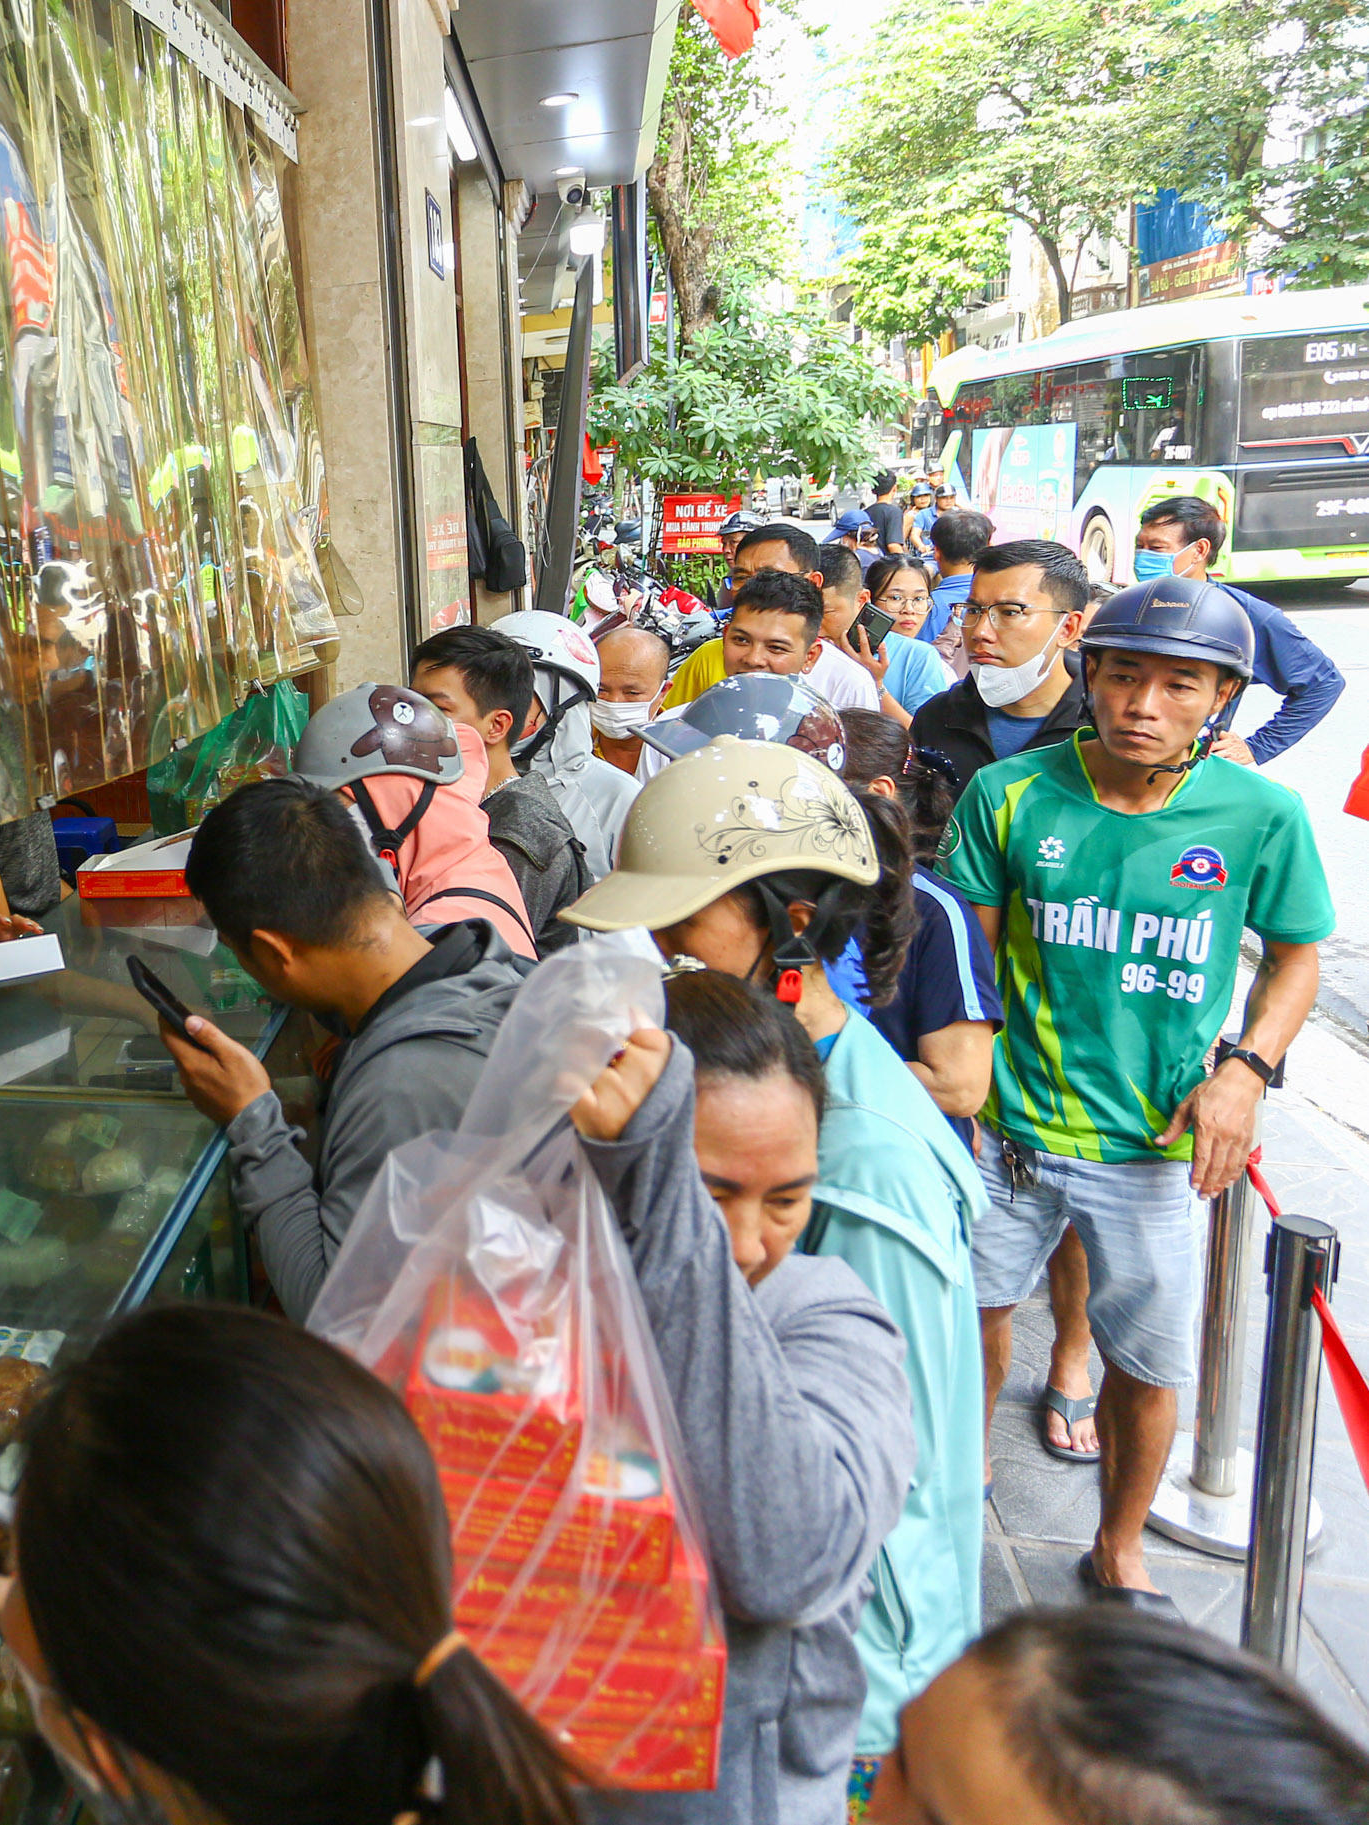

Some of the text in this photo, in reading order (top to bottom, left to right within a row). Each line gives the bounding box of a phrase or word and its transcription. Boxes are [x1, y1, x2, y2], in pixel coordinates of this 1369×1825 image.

[1305, 340, 1339, 363] E05
[675, 499, 728, 518] NƠI ĐỂ XE
[1026, 895, 1213, 965] TRẦN PHÚ
[1120, 962, 1206, 1004] 96-99
